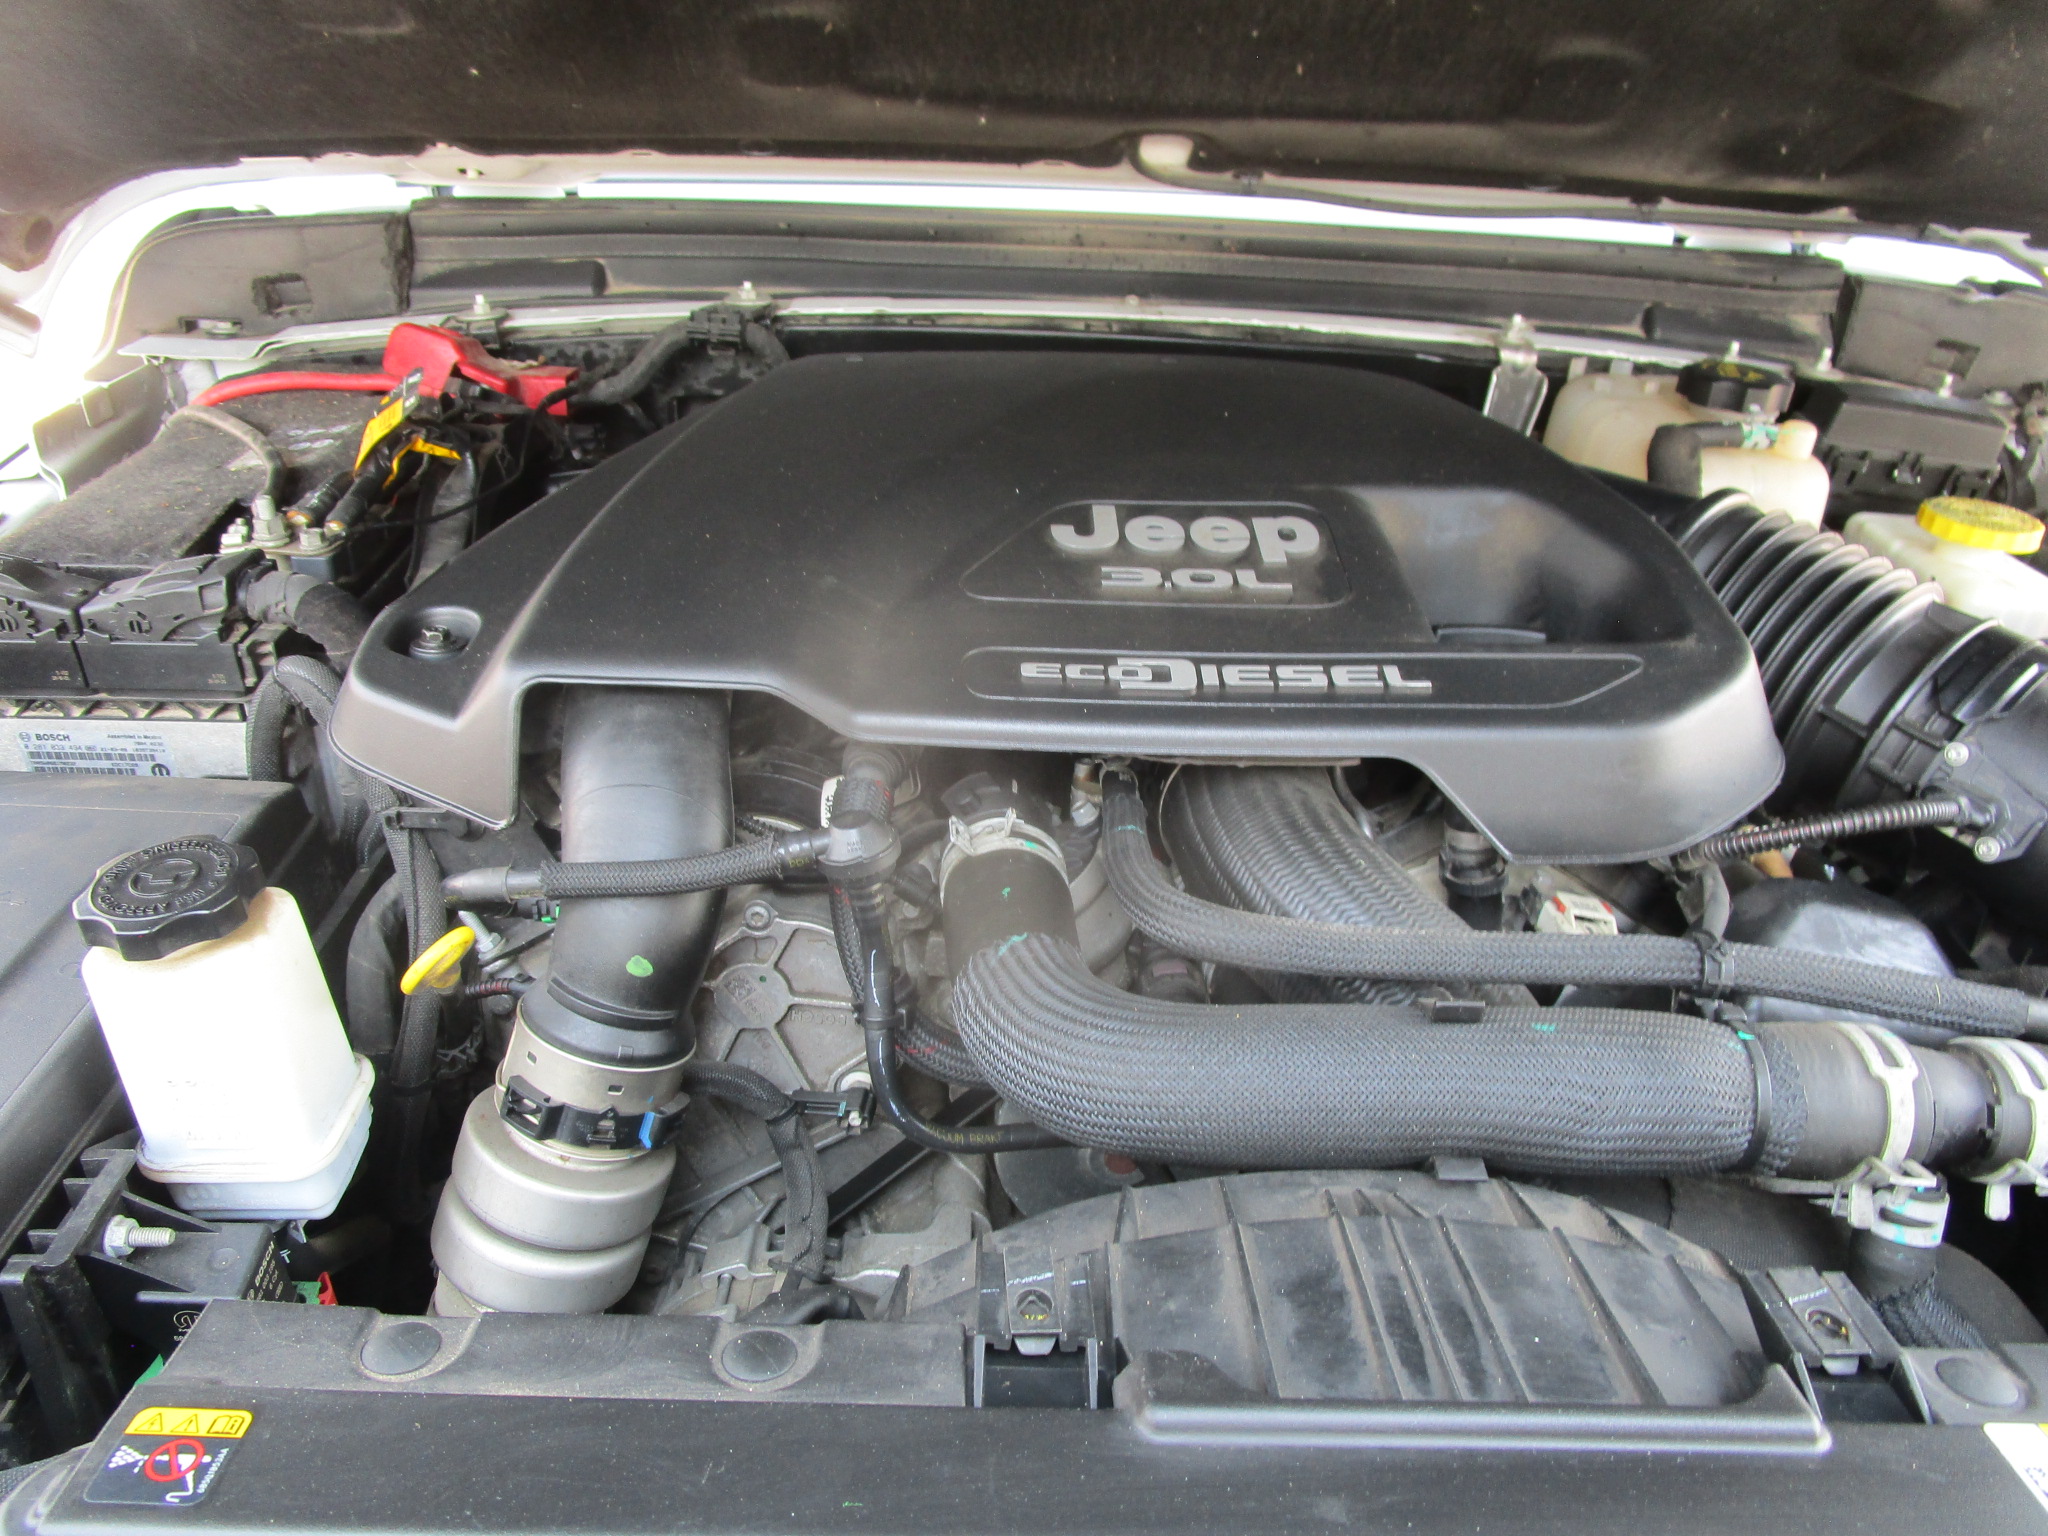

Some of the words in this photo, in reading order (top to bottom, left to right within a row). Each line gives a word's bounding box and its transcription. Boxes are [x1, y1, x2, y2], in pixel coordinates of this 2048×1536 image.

[1050, 503, 1320, 565] Jeep
[1100, 565, 1293, 592] 3.0L
[35, 733, 71, 742] BOSCH
[254, 1240, 275, 1288] BOSCH
